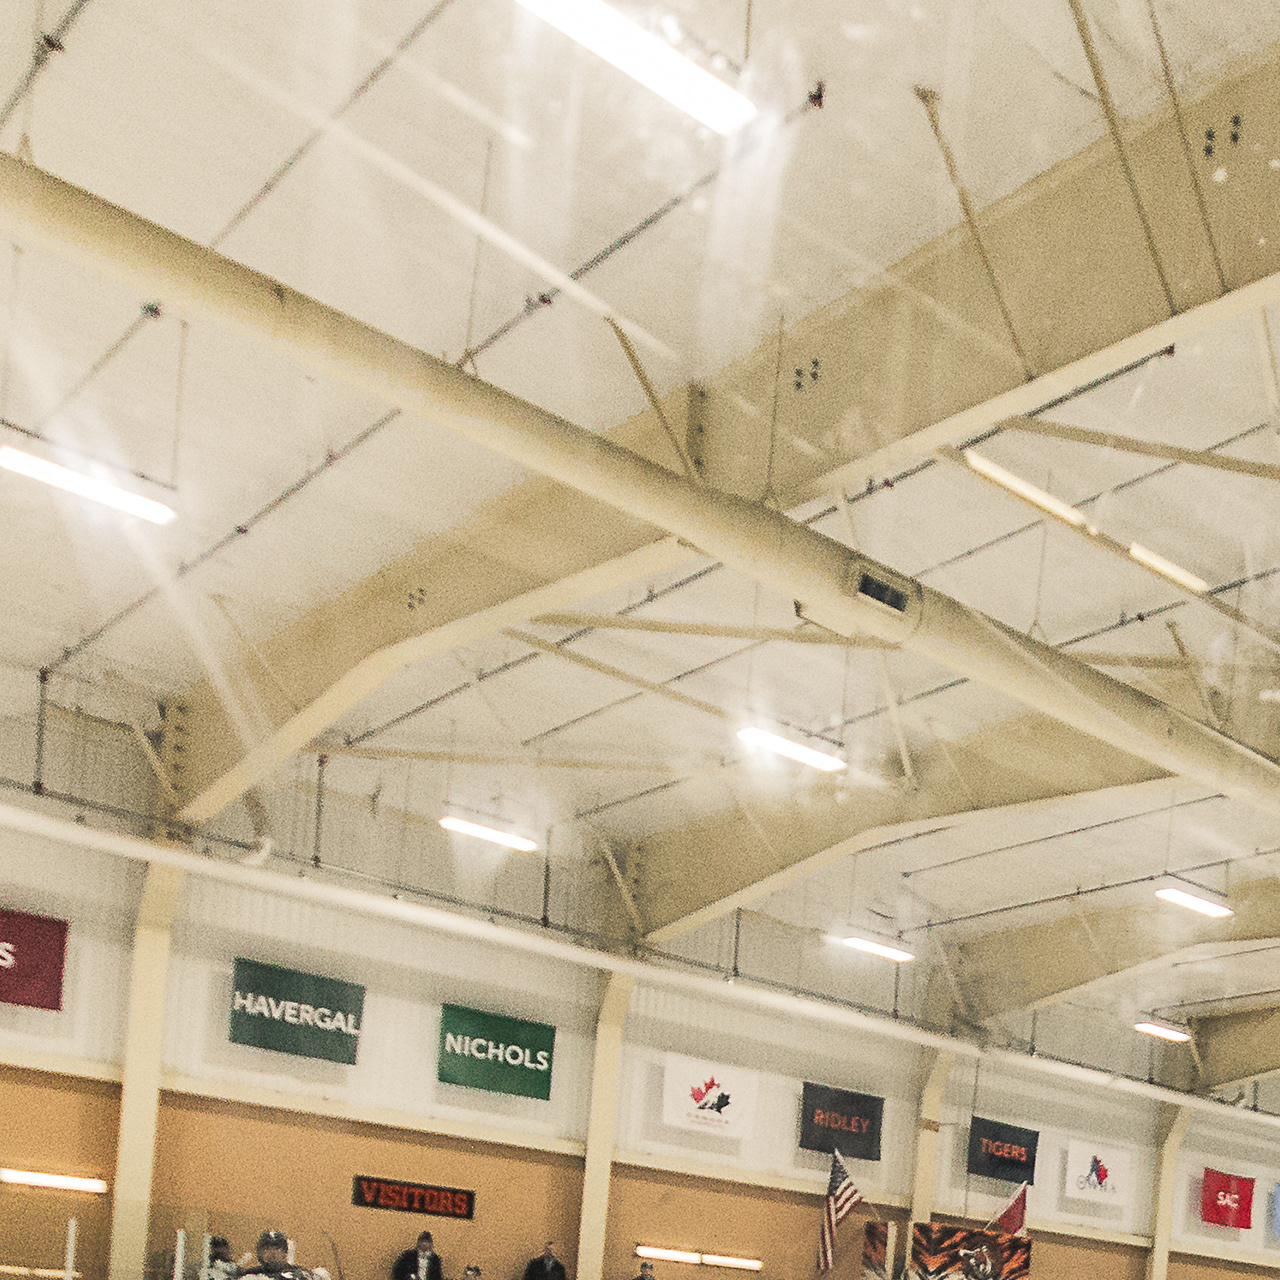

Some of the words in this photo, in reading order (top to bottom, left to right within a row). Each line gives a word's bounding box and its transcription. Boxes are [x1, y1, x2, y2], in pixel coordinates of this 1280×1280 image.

[232, 991, 361, 1036] HAVERGAL
[443, 1032, 550, 1071] NICHOLS
[813, 1108, 870, 1136] RIDLEY
[980, 1136, 1027, 1163] TIGERS
[358, 1179, 469, 1217] VISITORS
